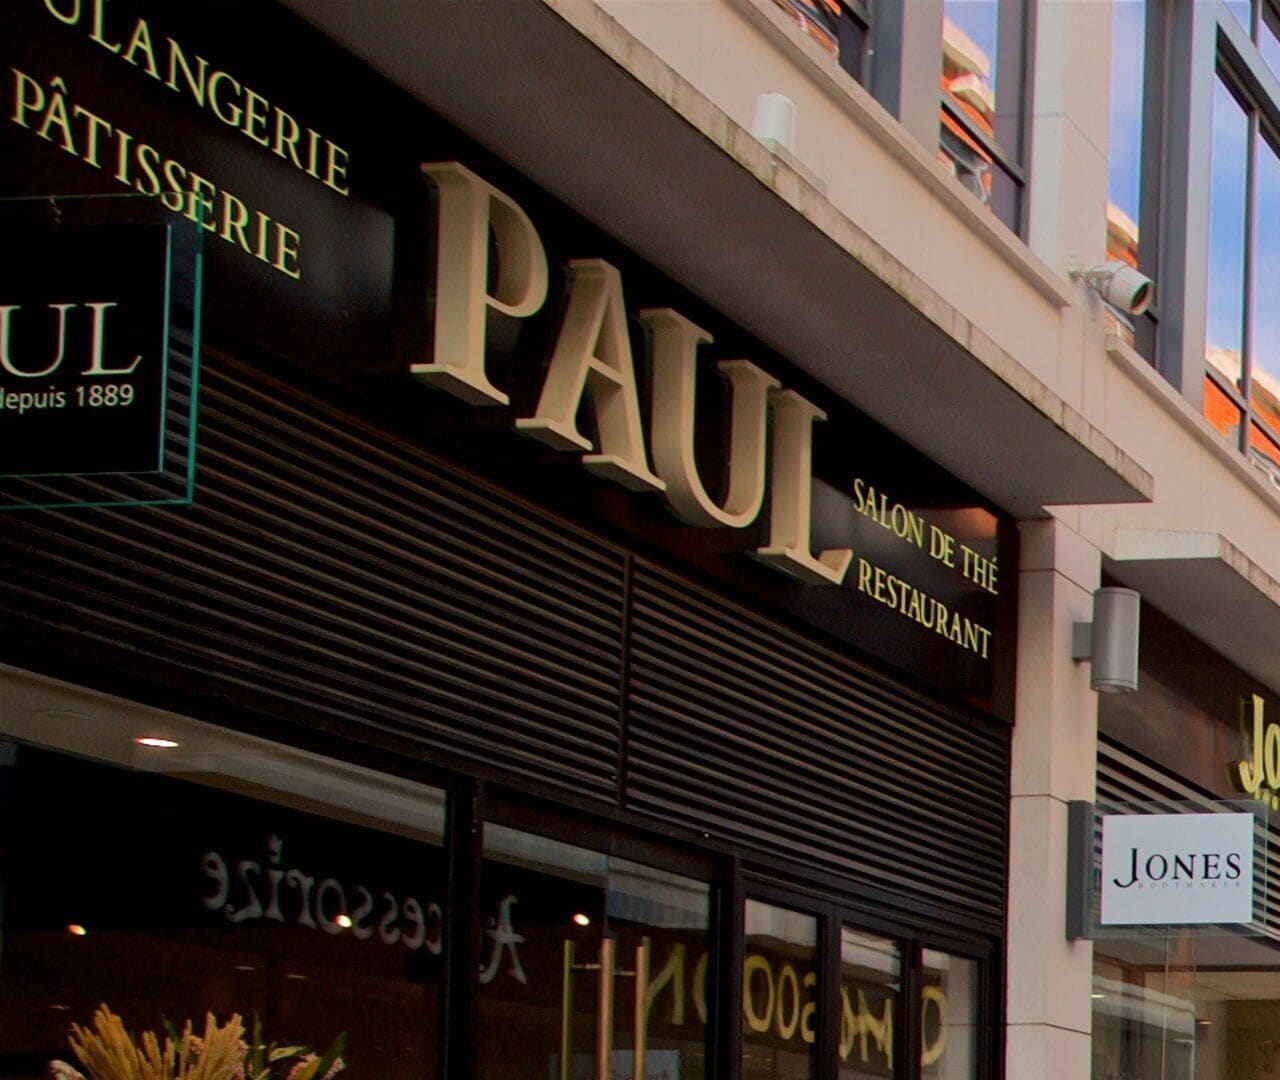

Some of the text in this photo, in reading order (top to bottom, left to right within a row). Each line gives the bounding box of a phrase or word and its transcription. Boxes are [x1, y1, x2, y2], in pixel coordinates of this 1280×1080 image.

[11, 68, 301, 281] PÂTISSERIE
[75, 384, 134, 407] 1889
[410, 161, 853, 586] PAUL
[853, 478, 999, 596] SALON DE THÉ
[858, 557, 992, 660] RESTAURANT
[1113, 848, 1242, 888] JONES
